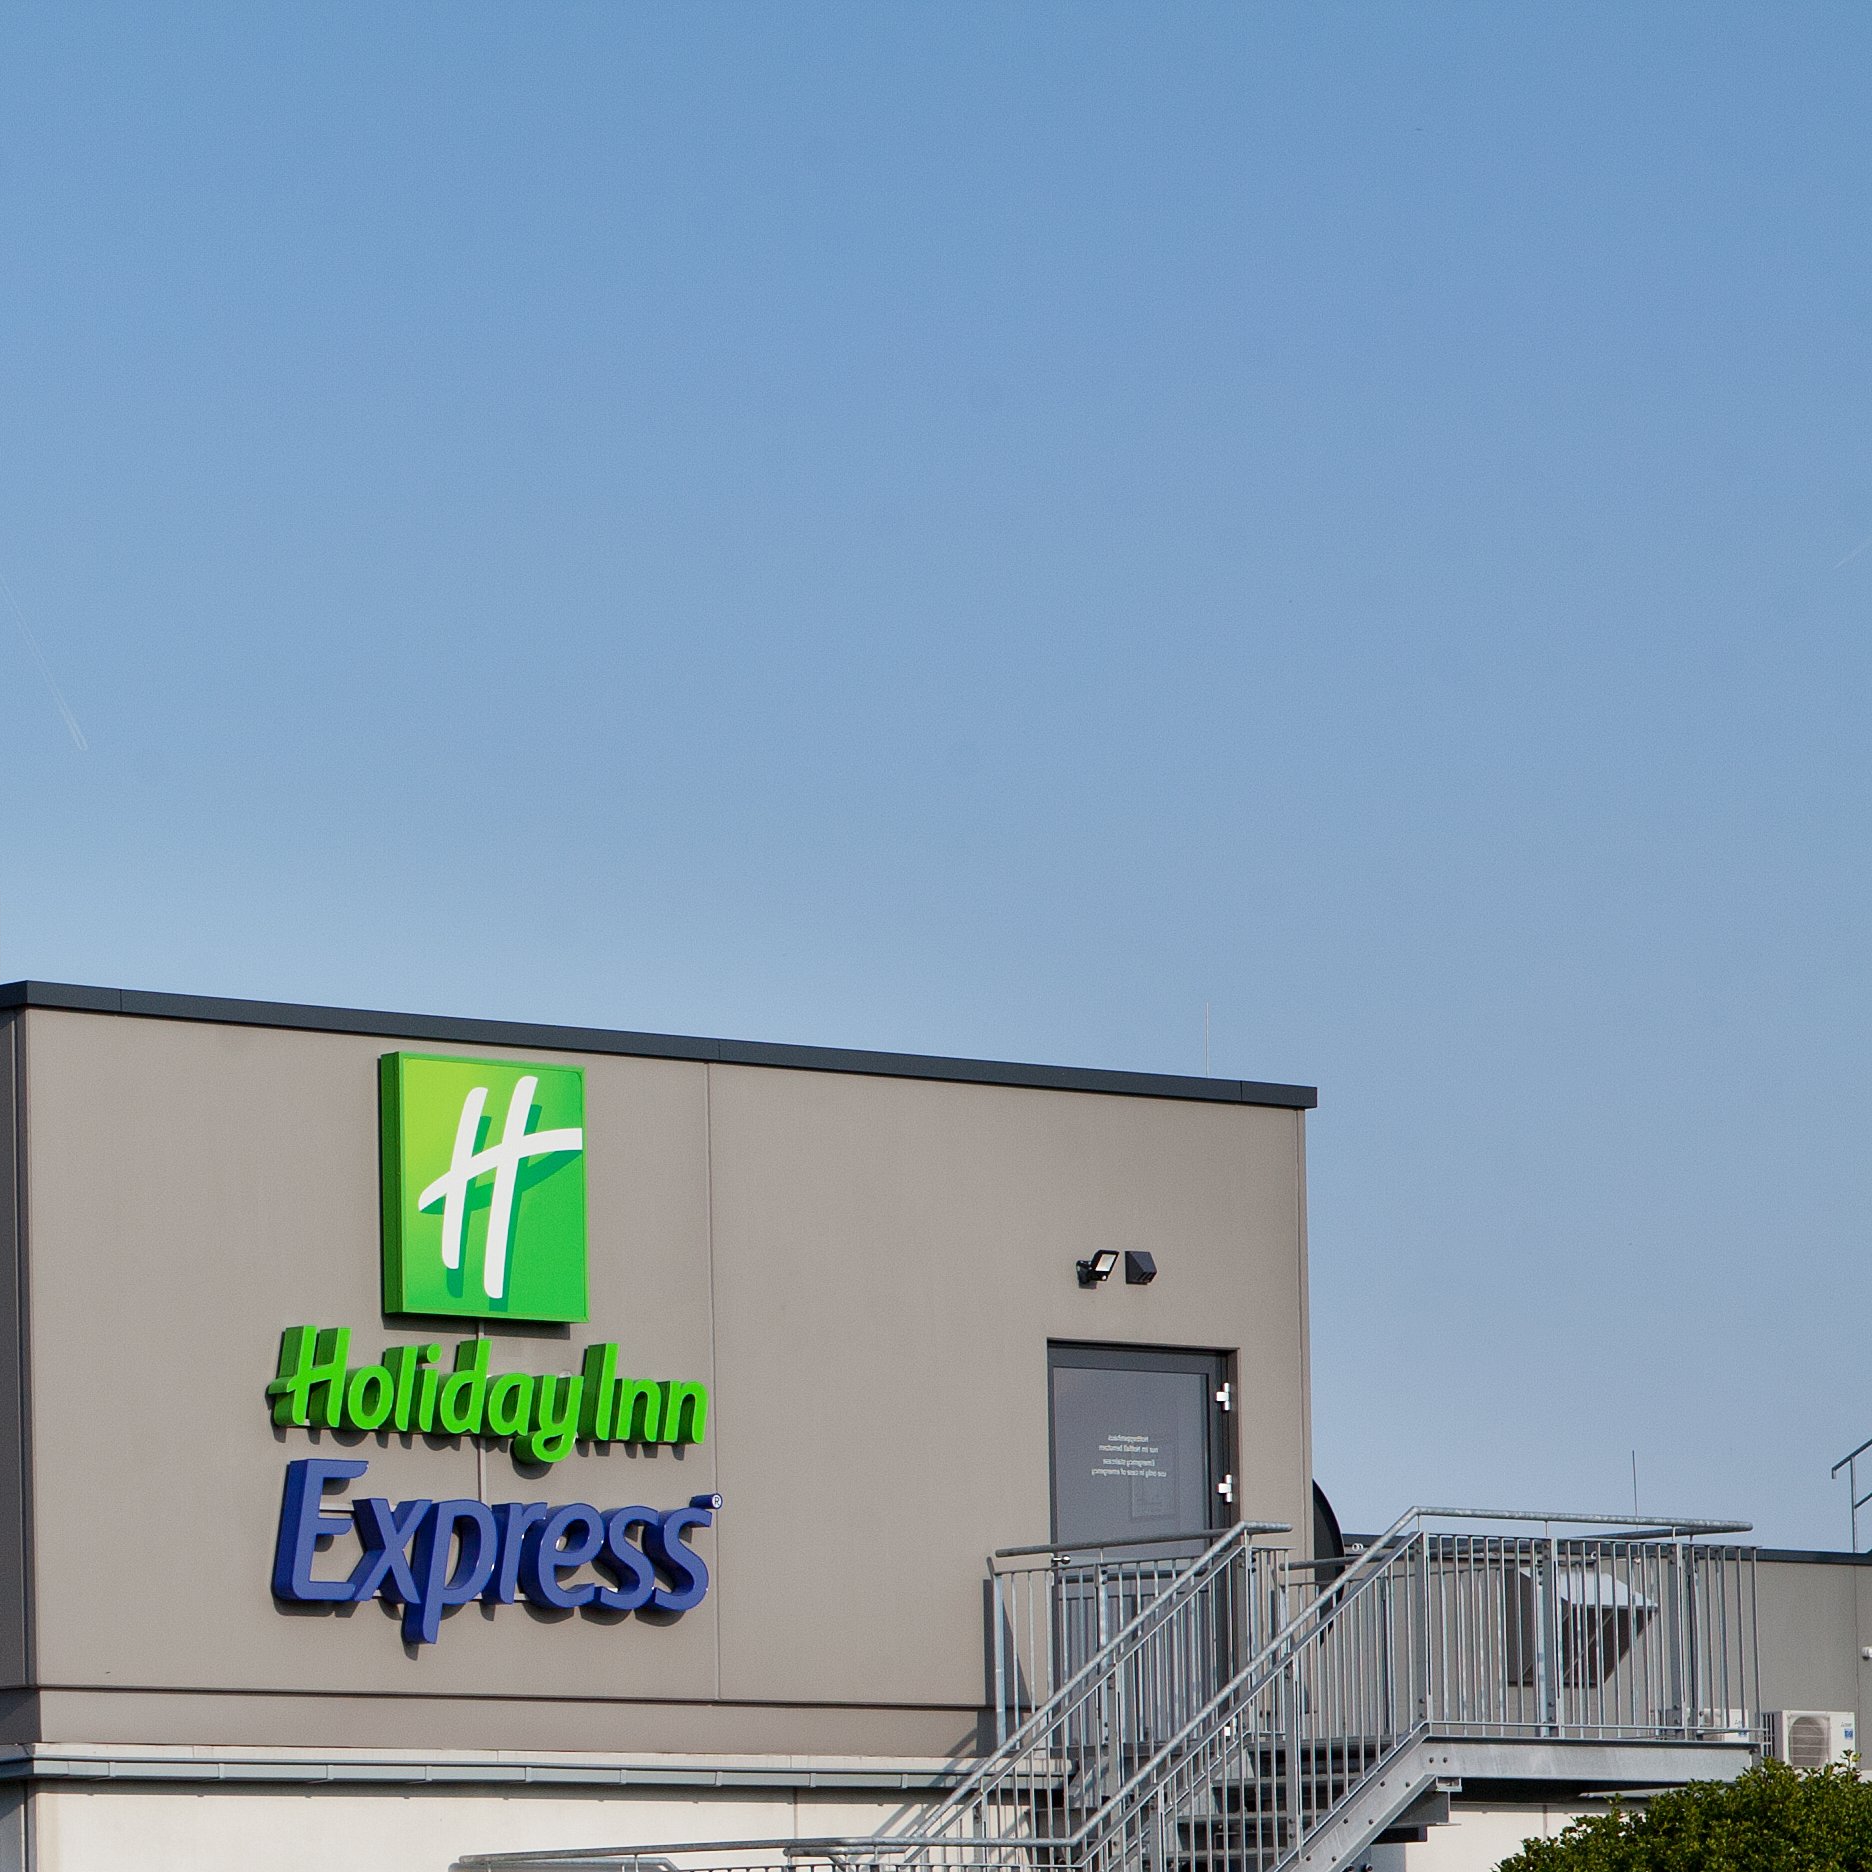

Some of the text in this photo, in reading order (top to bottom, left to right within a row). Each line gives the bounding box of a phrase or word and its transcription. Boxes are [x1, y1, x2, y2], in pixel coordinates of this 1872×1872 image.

[268, 1325, 708, 1463] Holiday Inn
[273, 1458, 713, 1645] Express
